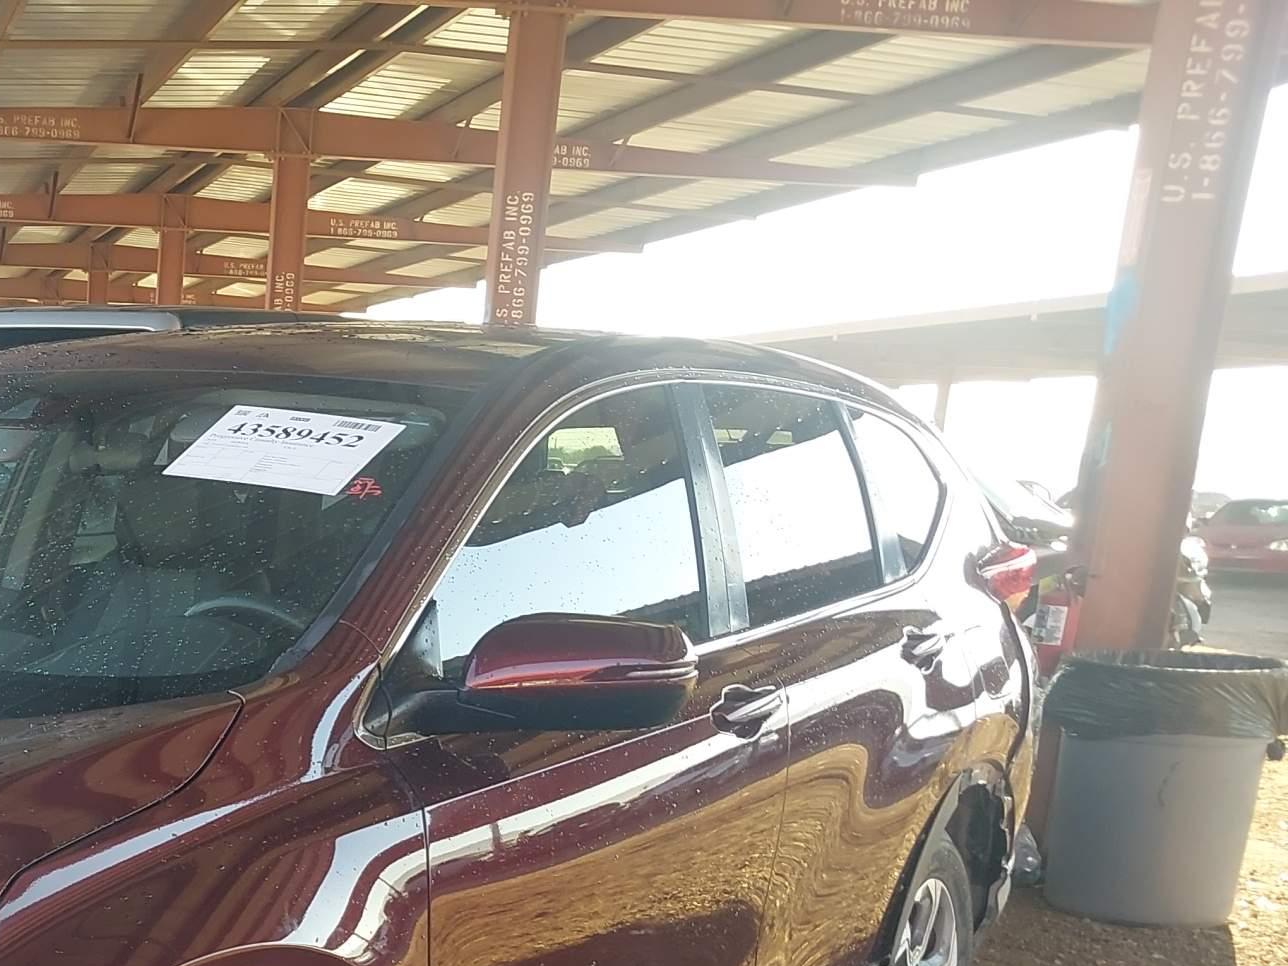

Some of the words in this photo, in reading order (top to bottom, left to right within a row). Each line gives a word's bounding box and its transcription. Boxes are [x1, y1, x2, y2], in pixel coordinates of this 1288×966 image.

[1176, 0, 1223, 121] PREFA
[1191, 2, 1250, 201] 1-866-799-
[571, 145, 592, 158] INC.
[1161, 140, 1196, 202] U.S.
[504, 190, 521, 221] INC.
[498, 229, 516, 294] PREFAB
[510, 191, 534, 326] -866-799-0969
[227, 421, 365, 448] 43589452
